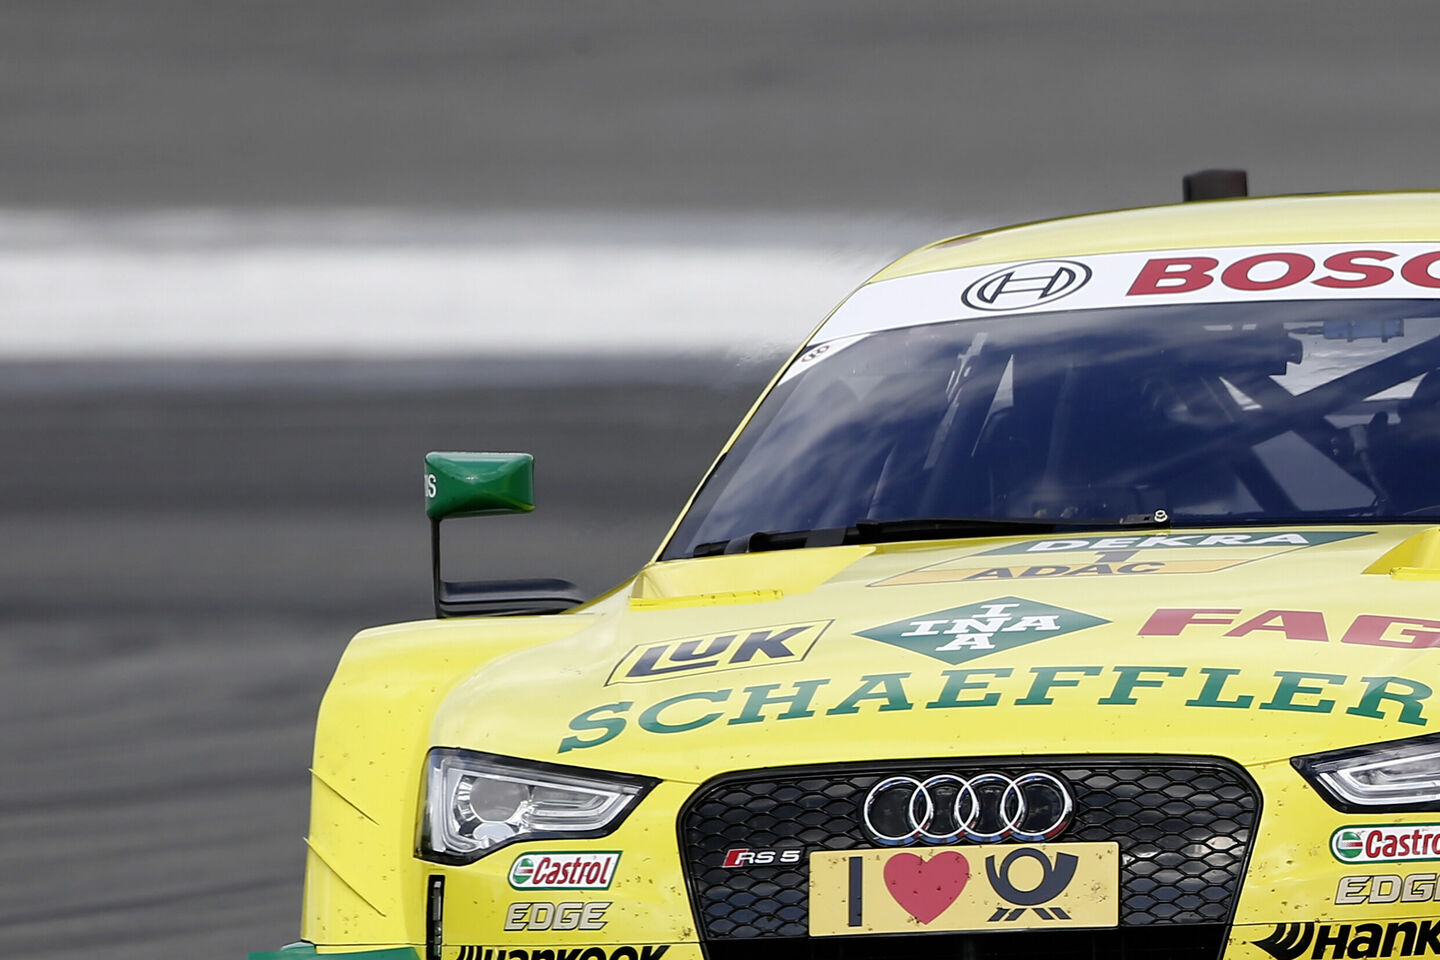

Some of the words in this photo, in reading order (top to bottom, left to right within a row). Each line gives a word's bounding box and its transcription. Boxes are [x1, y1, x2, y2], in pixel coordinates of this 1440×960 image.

[1027, 532, 1311, 552] DEKRA
[964, 561, 1166, 580] ADAC
[557, 664, 1434, 754] SCHAEFFLER
[734, 851, 776, 865] RS
[779, 849, 801, 863] 5
[532, 856, 612, 885] Castrol
[503, 901, 614, 931] EDGE
